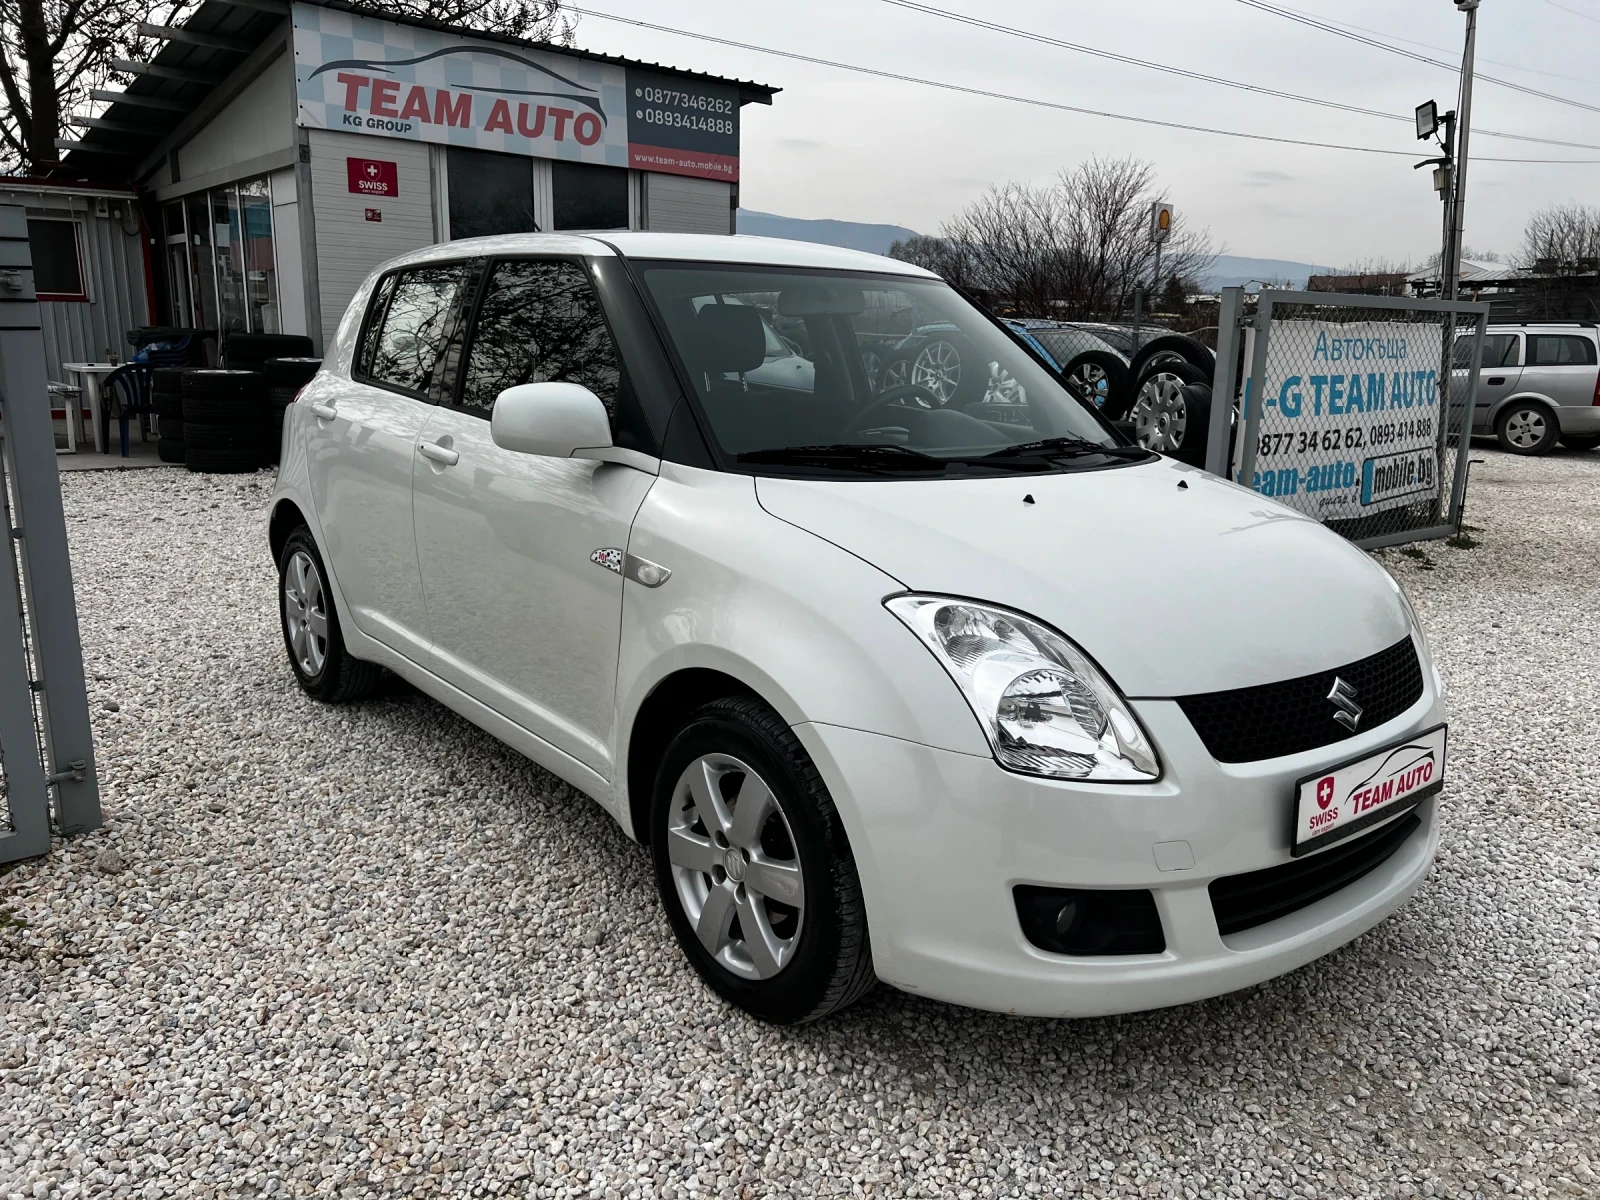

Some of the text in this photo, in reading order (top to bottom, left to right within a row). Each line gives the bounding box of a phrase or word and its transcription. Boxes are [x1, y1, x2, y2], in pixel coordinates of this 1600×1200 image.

[337, 73, 601, 146] TEAM AUTO
[645, 87, 732, 114] 0877346262
[342, 113, 412, 133] KG GROUP
[646, 109, 733, 134] 0893414888
[634, 154, 733, 174] www.team-auto.mobile.bg
[358, 180, 388, 191] SWISS
[1313, 331, 1406, 361] Автокъща
[1310, 372, 1385, 416] TEAM
[1391, 370, 1436, 410] AUTO
[1298, 431, 1318, 452] 34
[1321, 429, 1341, 451] 62
[1345, 426, 1366, 450] 62,
[1369, 421, 1396, 445] 0893
[1397, 420, 1414, 439] 414
[1416, 417, 1431, 437] 888
[1373, 455, 1433, 493] mobile.bg
[1353, 762, 1433, 814] TEAM AUTO
[1310, 807, 1338, 829] SWISS
